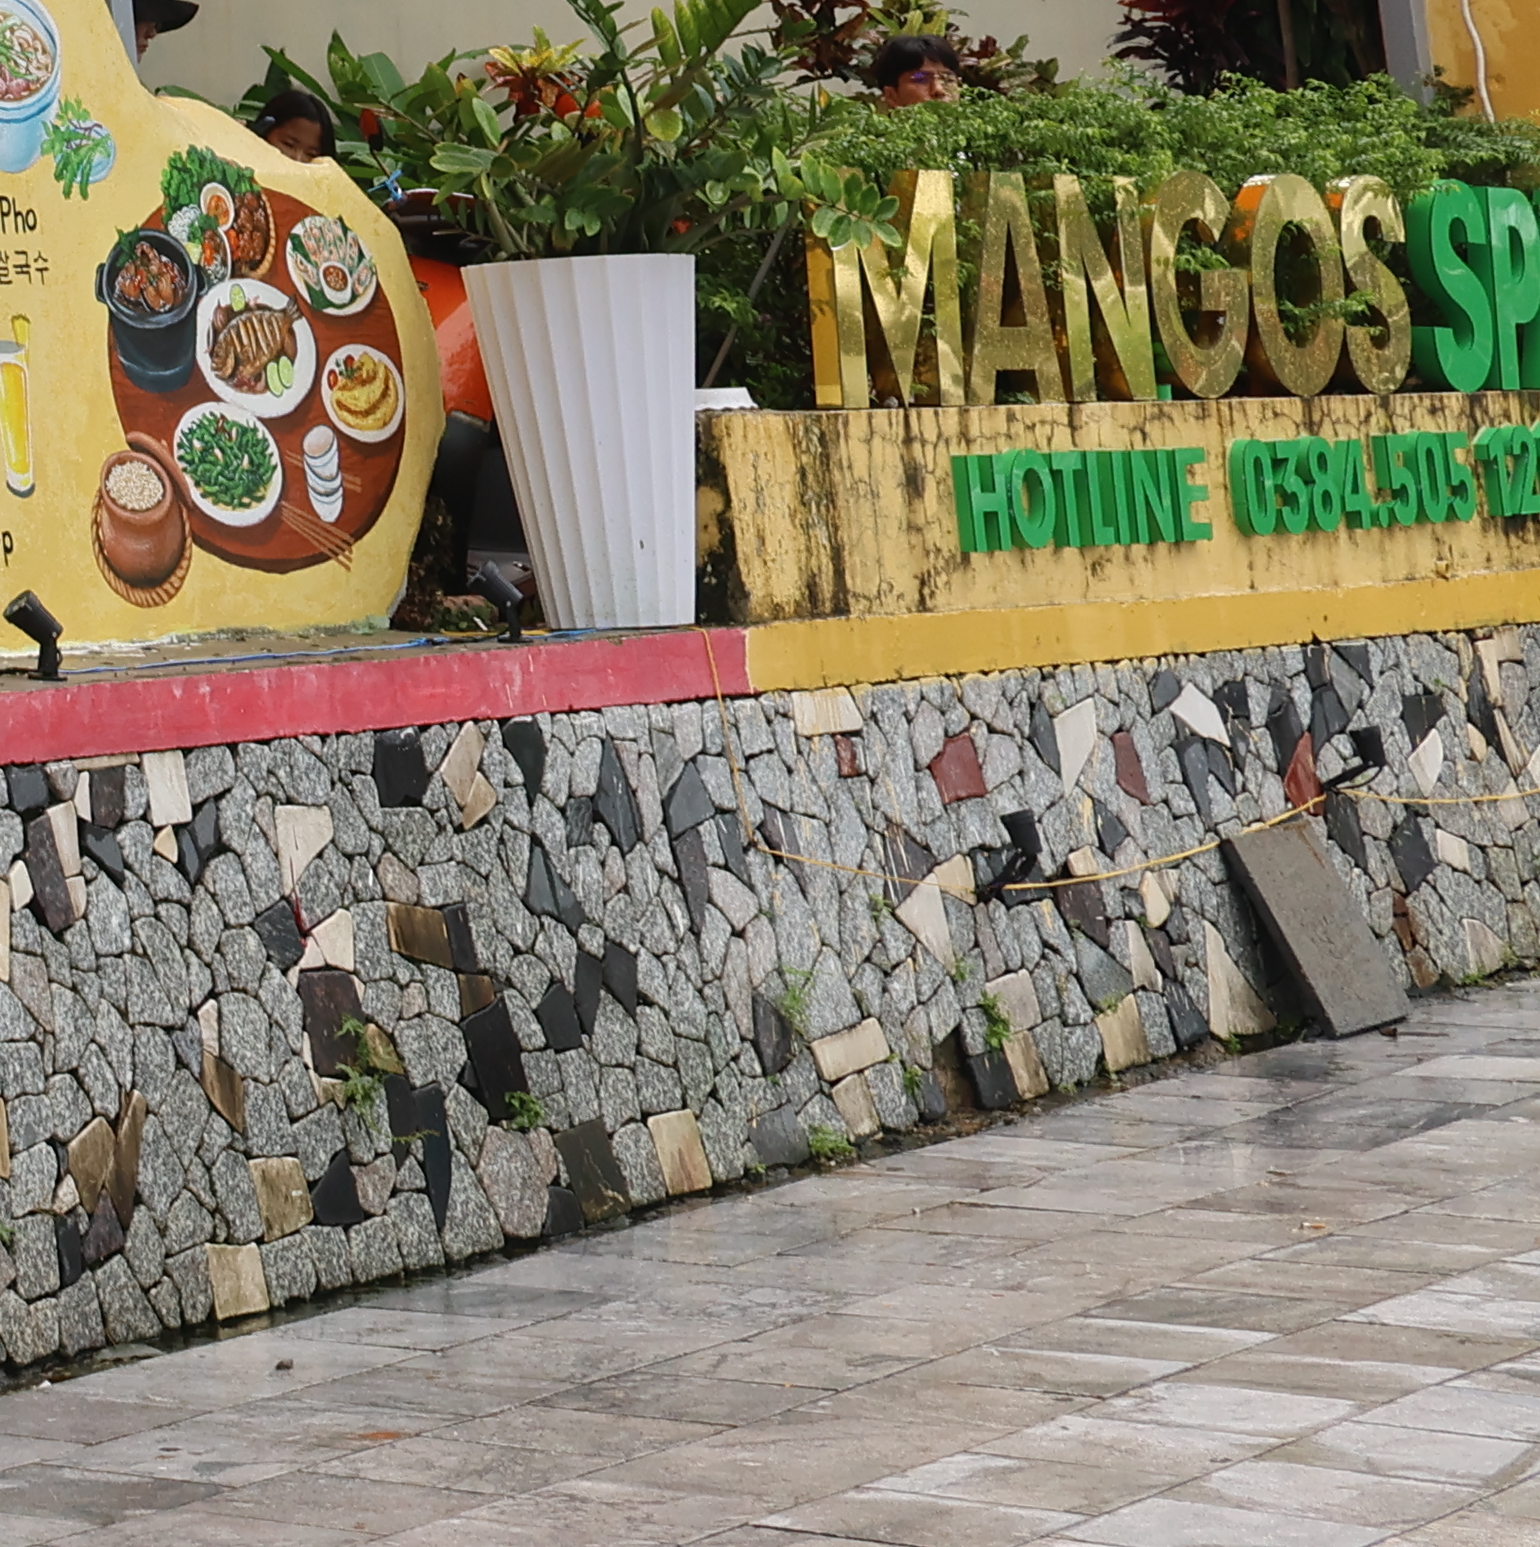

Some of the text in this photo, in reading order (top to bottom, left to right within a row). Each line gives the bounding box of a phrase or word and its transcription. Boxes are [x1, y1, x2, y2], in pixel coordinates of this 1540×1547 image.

[806, 169, 1540, 410] MANGOS SP
[951, 447, 1214, 552] HOTLINE
[1472, 422, 1540, 517] 12
